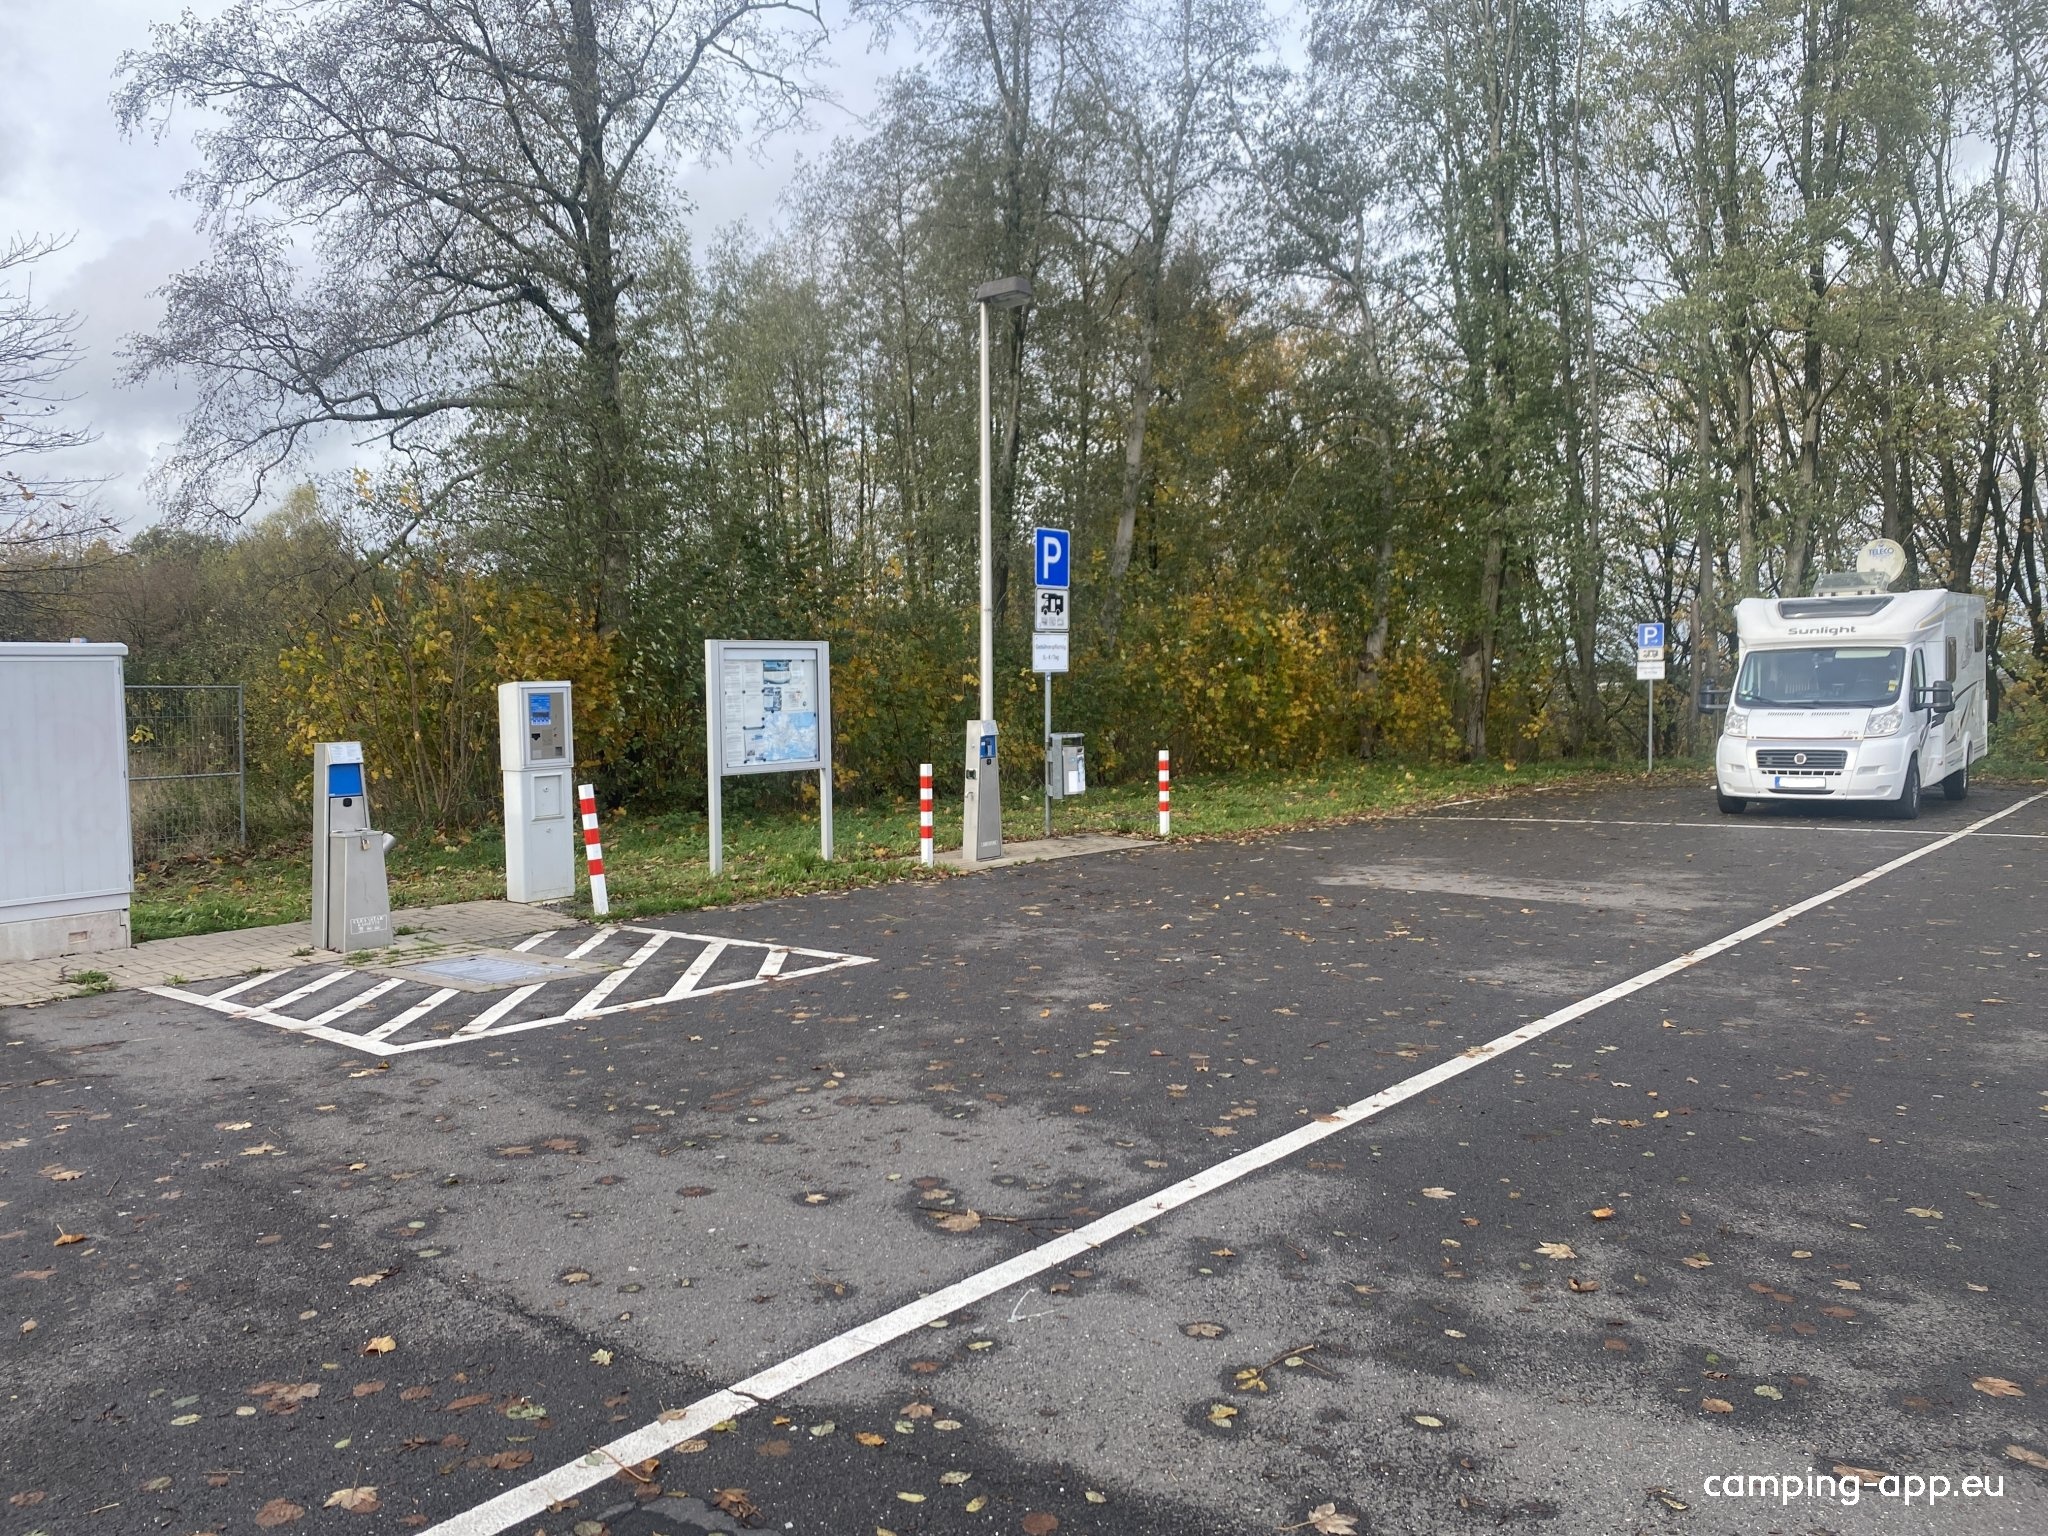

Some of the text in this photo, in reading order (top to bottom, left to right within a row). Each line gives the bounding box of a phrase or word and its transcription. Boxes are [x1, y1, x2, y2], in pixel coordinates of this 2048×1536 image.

[1043, 536, 1062, 579] P
[1869, 547, 1895, 557] TELECO
[1644, 626, 1658, 645] P
[1788, 626, 1857, 636] Sunlight
